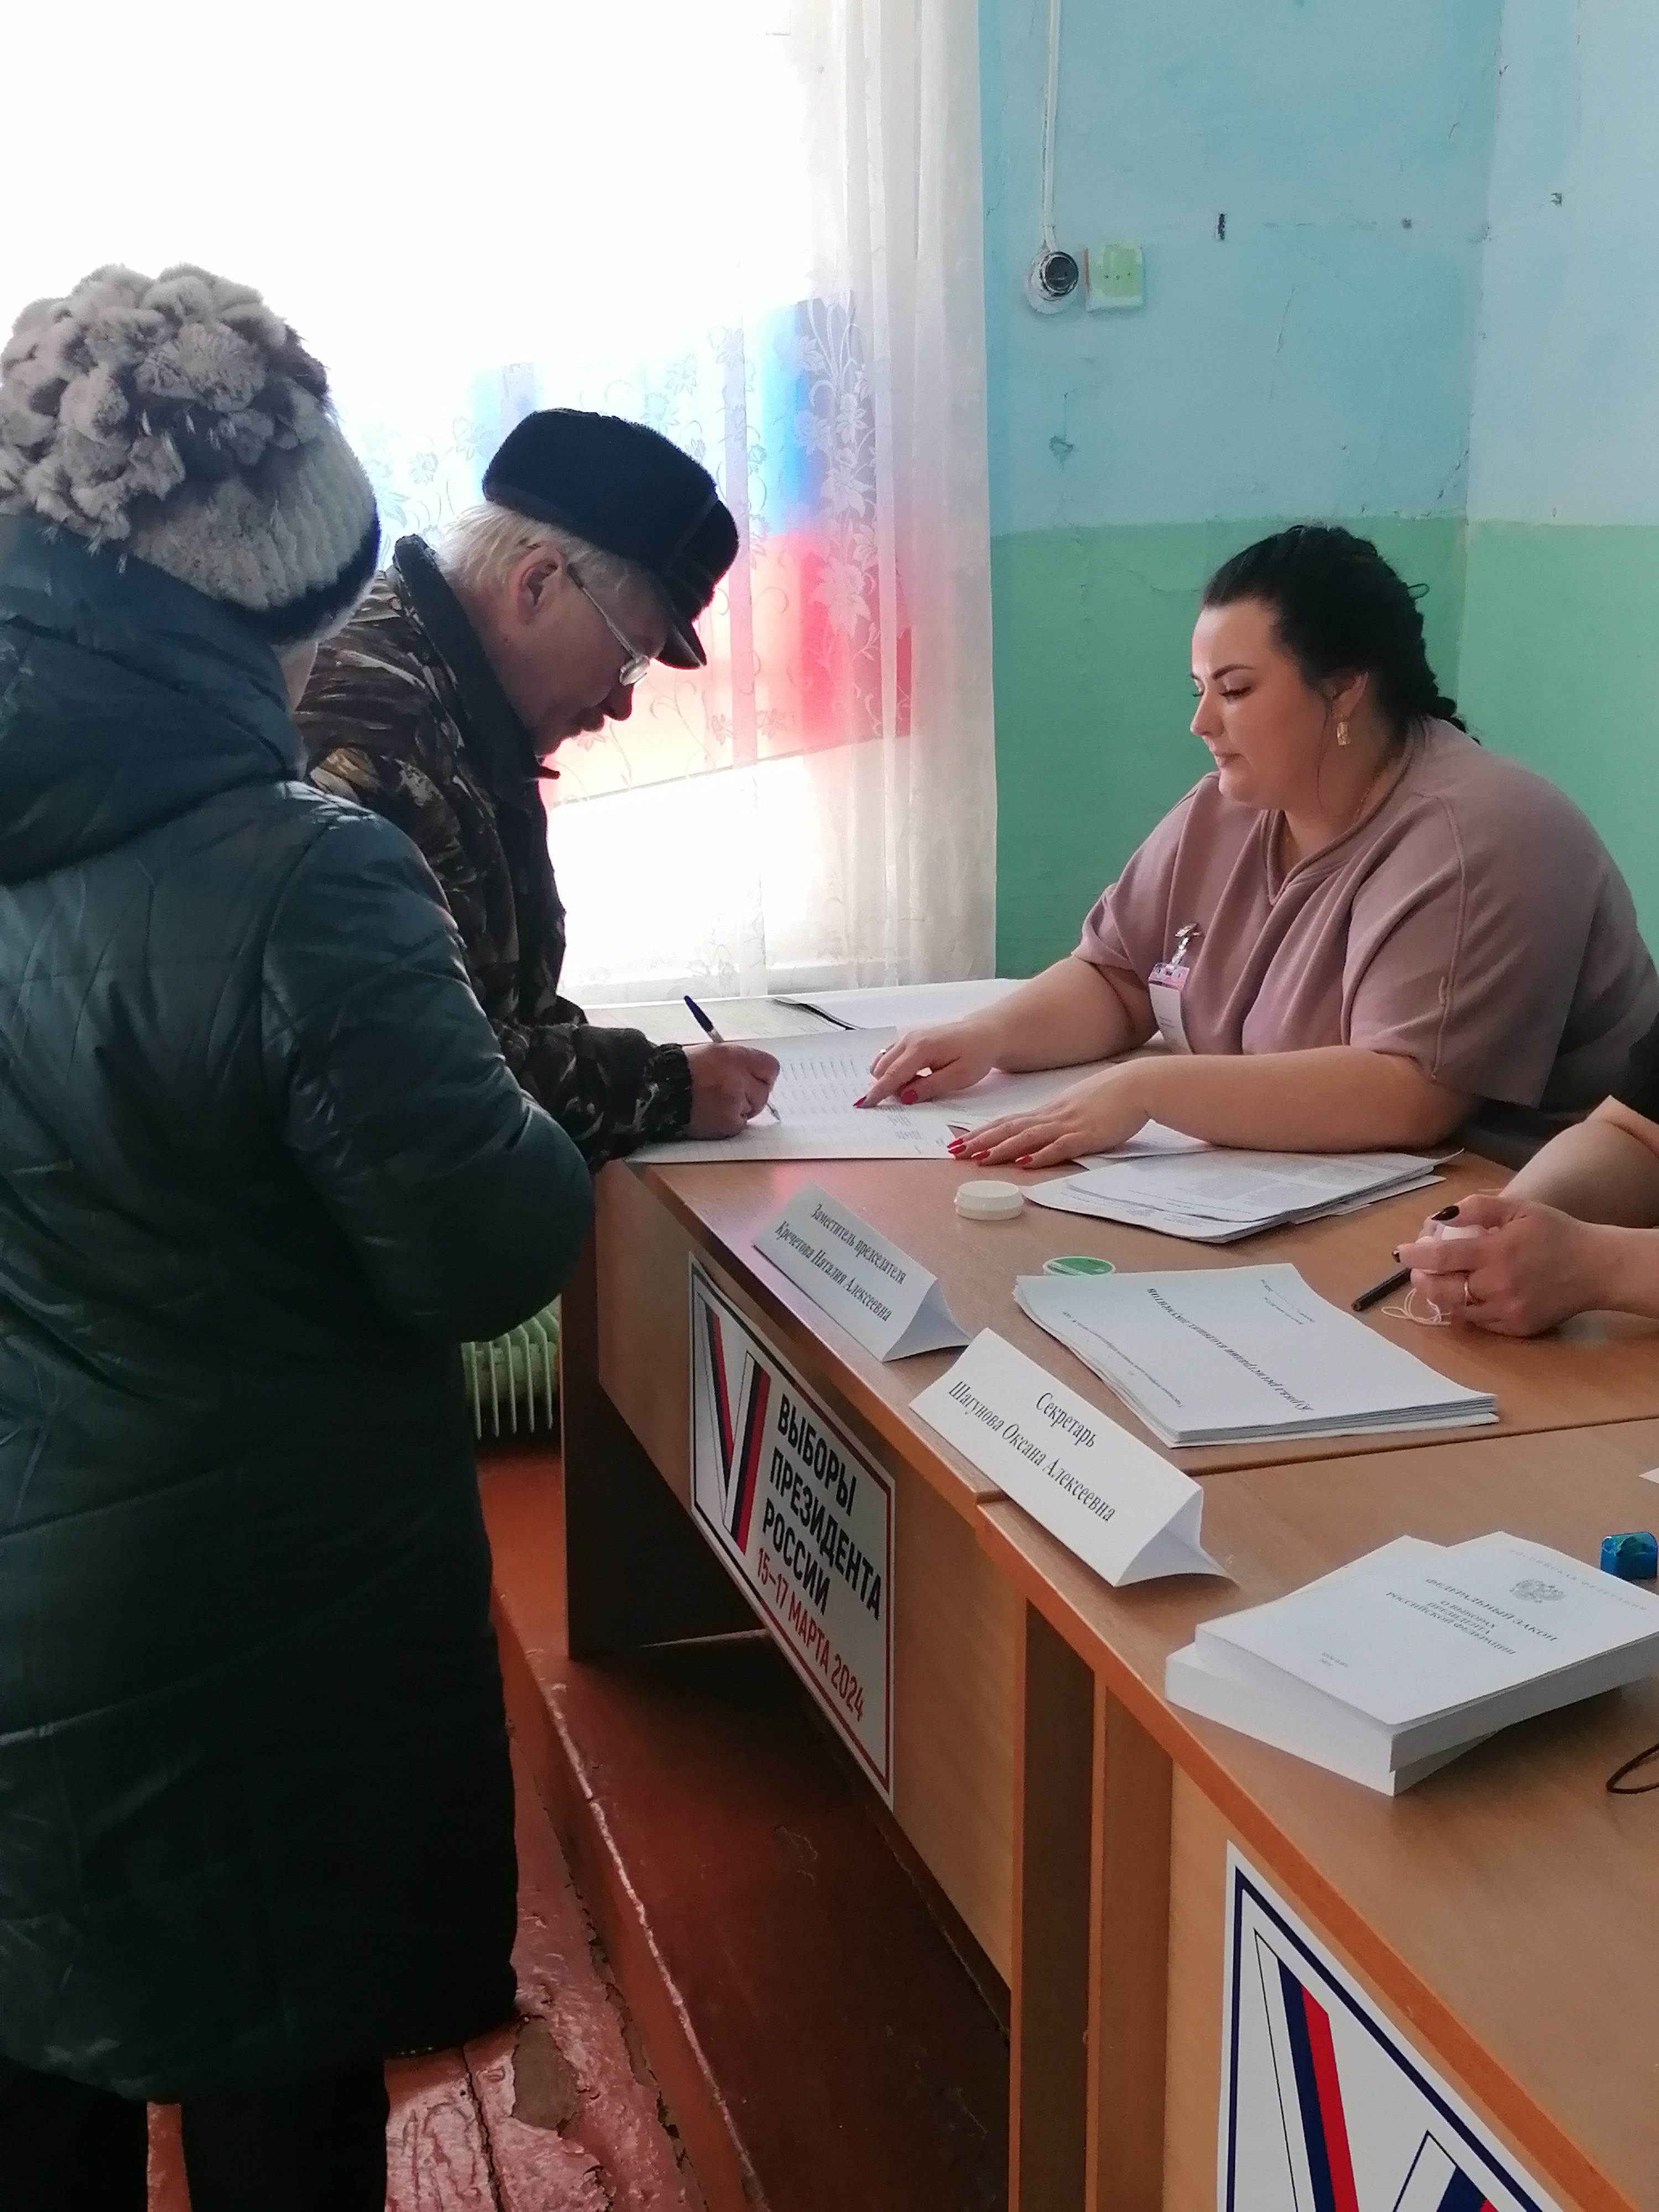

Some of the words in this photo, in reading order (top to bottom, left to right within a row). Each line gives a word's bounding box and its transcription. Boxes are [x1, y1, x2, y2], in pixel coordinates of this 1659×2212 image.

[775, 1221, 815, 1259] Кречетова
[811, 1249, 847, 1285] Наталия
[843, 1277, 893, 1322] Алексеевна
[811, 1203, 855, 1246] Заместитель
[854, 1240, 906, 1285] председателя
[1147, 1288, 1190, 1324] документов
[778, 1393, 857, 1517] ВЫБОРЫ
[948, 1381, 1004, 1432] Шагунова
[1001, 1424, 1046, 1467] Оксана
[1042, 1458, 1115, 1523] Алексеевна
[1036, 1392, 1096, 1448] Секретарь
[763, 1497, 830, 1615] РОССИИ
[770, 1447, 881, 1621] ПРЕЗИДЕНТА
[789, 1591, 830, 1676] МАРТА
[831, 1653, 864, 1721] 2024
[1386, 1592, 1455, 1624] РОССИЙСКОЙ
[1453, 1622, 1516, 1655] ФЕДЕРАЦИИ
[1426, 1578, 1515, 1620] ФЕДЕРАЛЬНЫЙ
[1512, 1618, 1558, 1641] ЗАКОН
